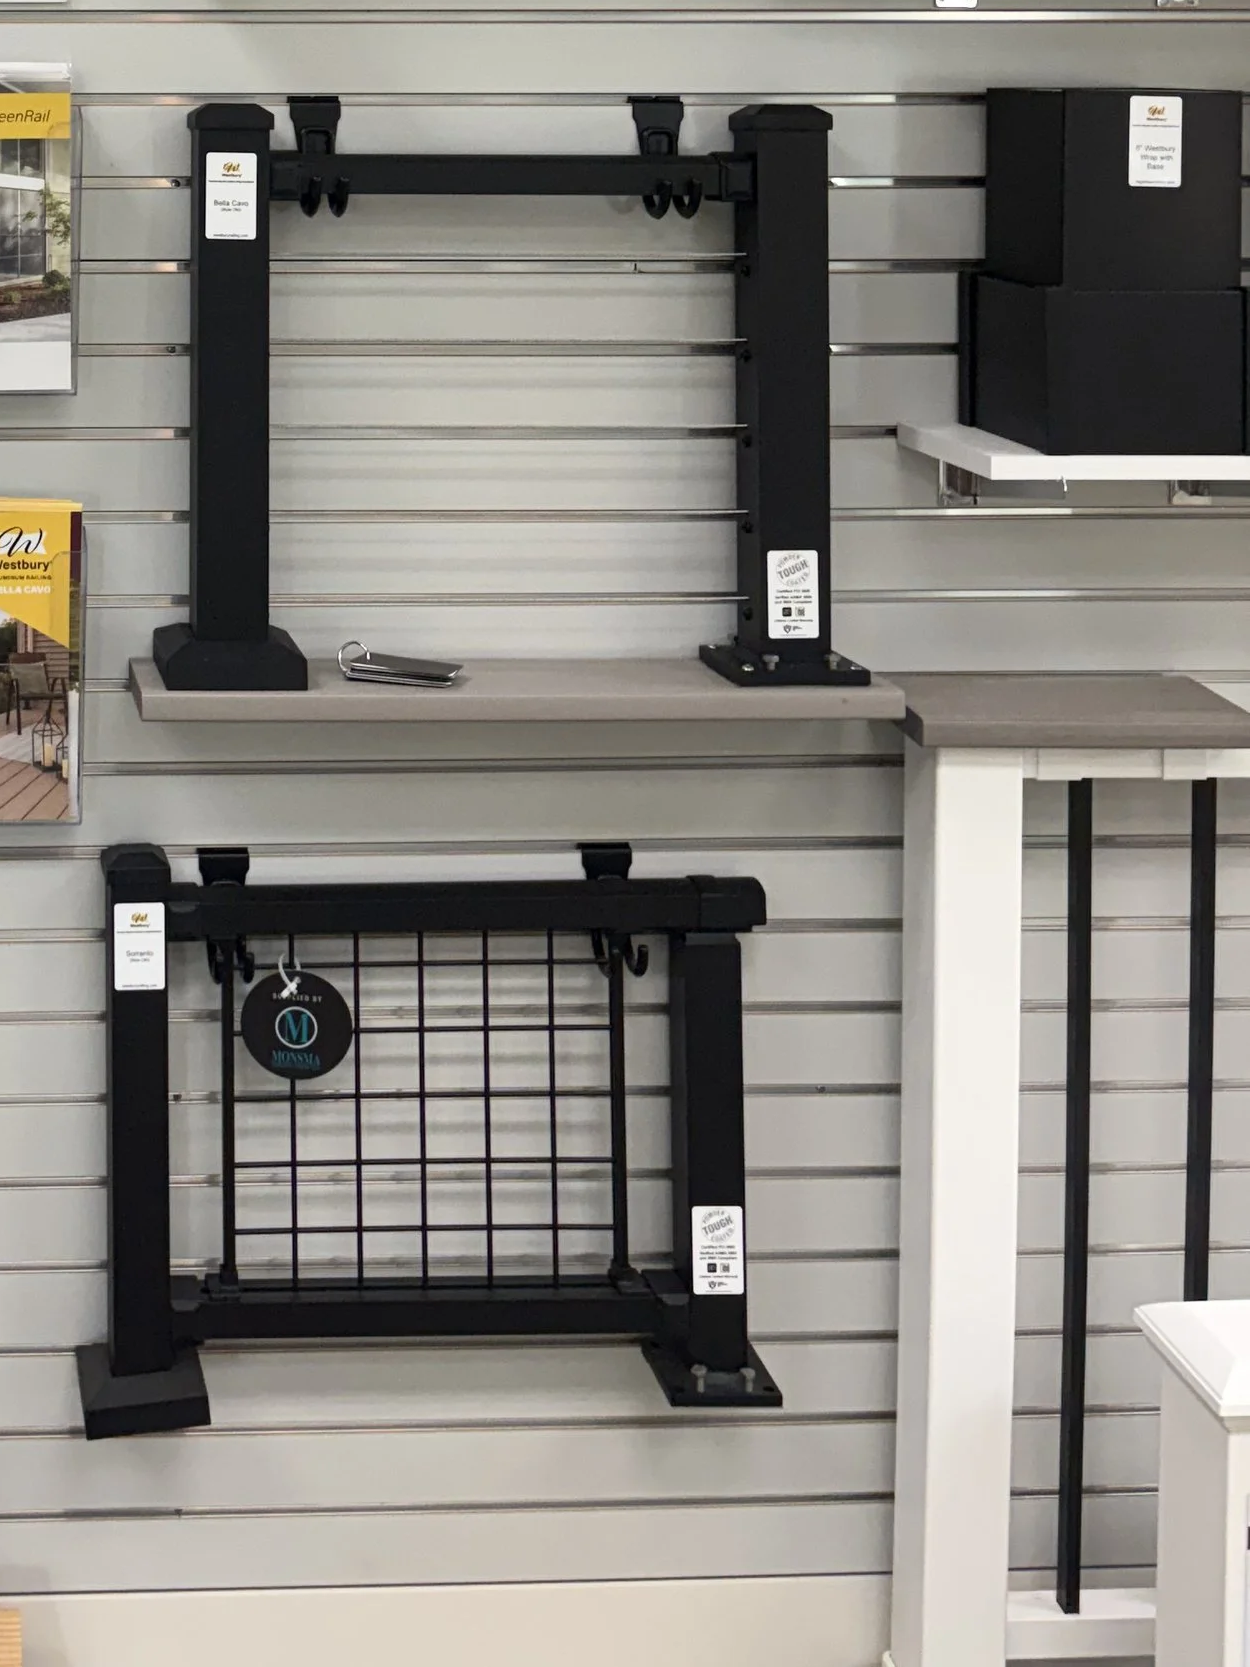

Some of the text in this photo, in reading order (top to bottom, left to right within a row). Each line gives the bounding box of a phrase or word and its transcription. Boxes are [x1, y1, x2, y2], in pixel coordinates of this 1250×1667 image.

[777, 559, 809, 579] TOUGH
[24, 585, 51, 594] CAVO
[272, 992, 309, 1002] SULIED
[285, 1011, 309, 1043] M
[272, 1049, 321, 1065] MONSMA
[702, 1215, 733, 1235] TOUGH
